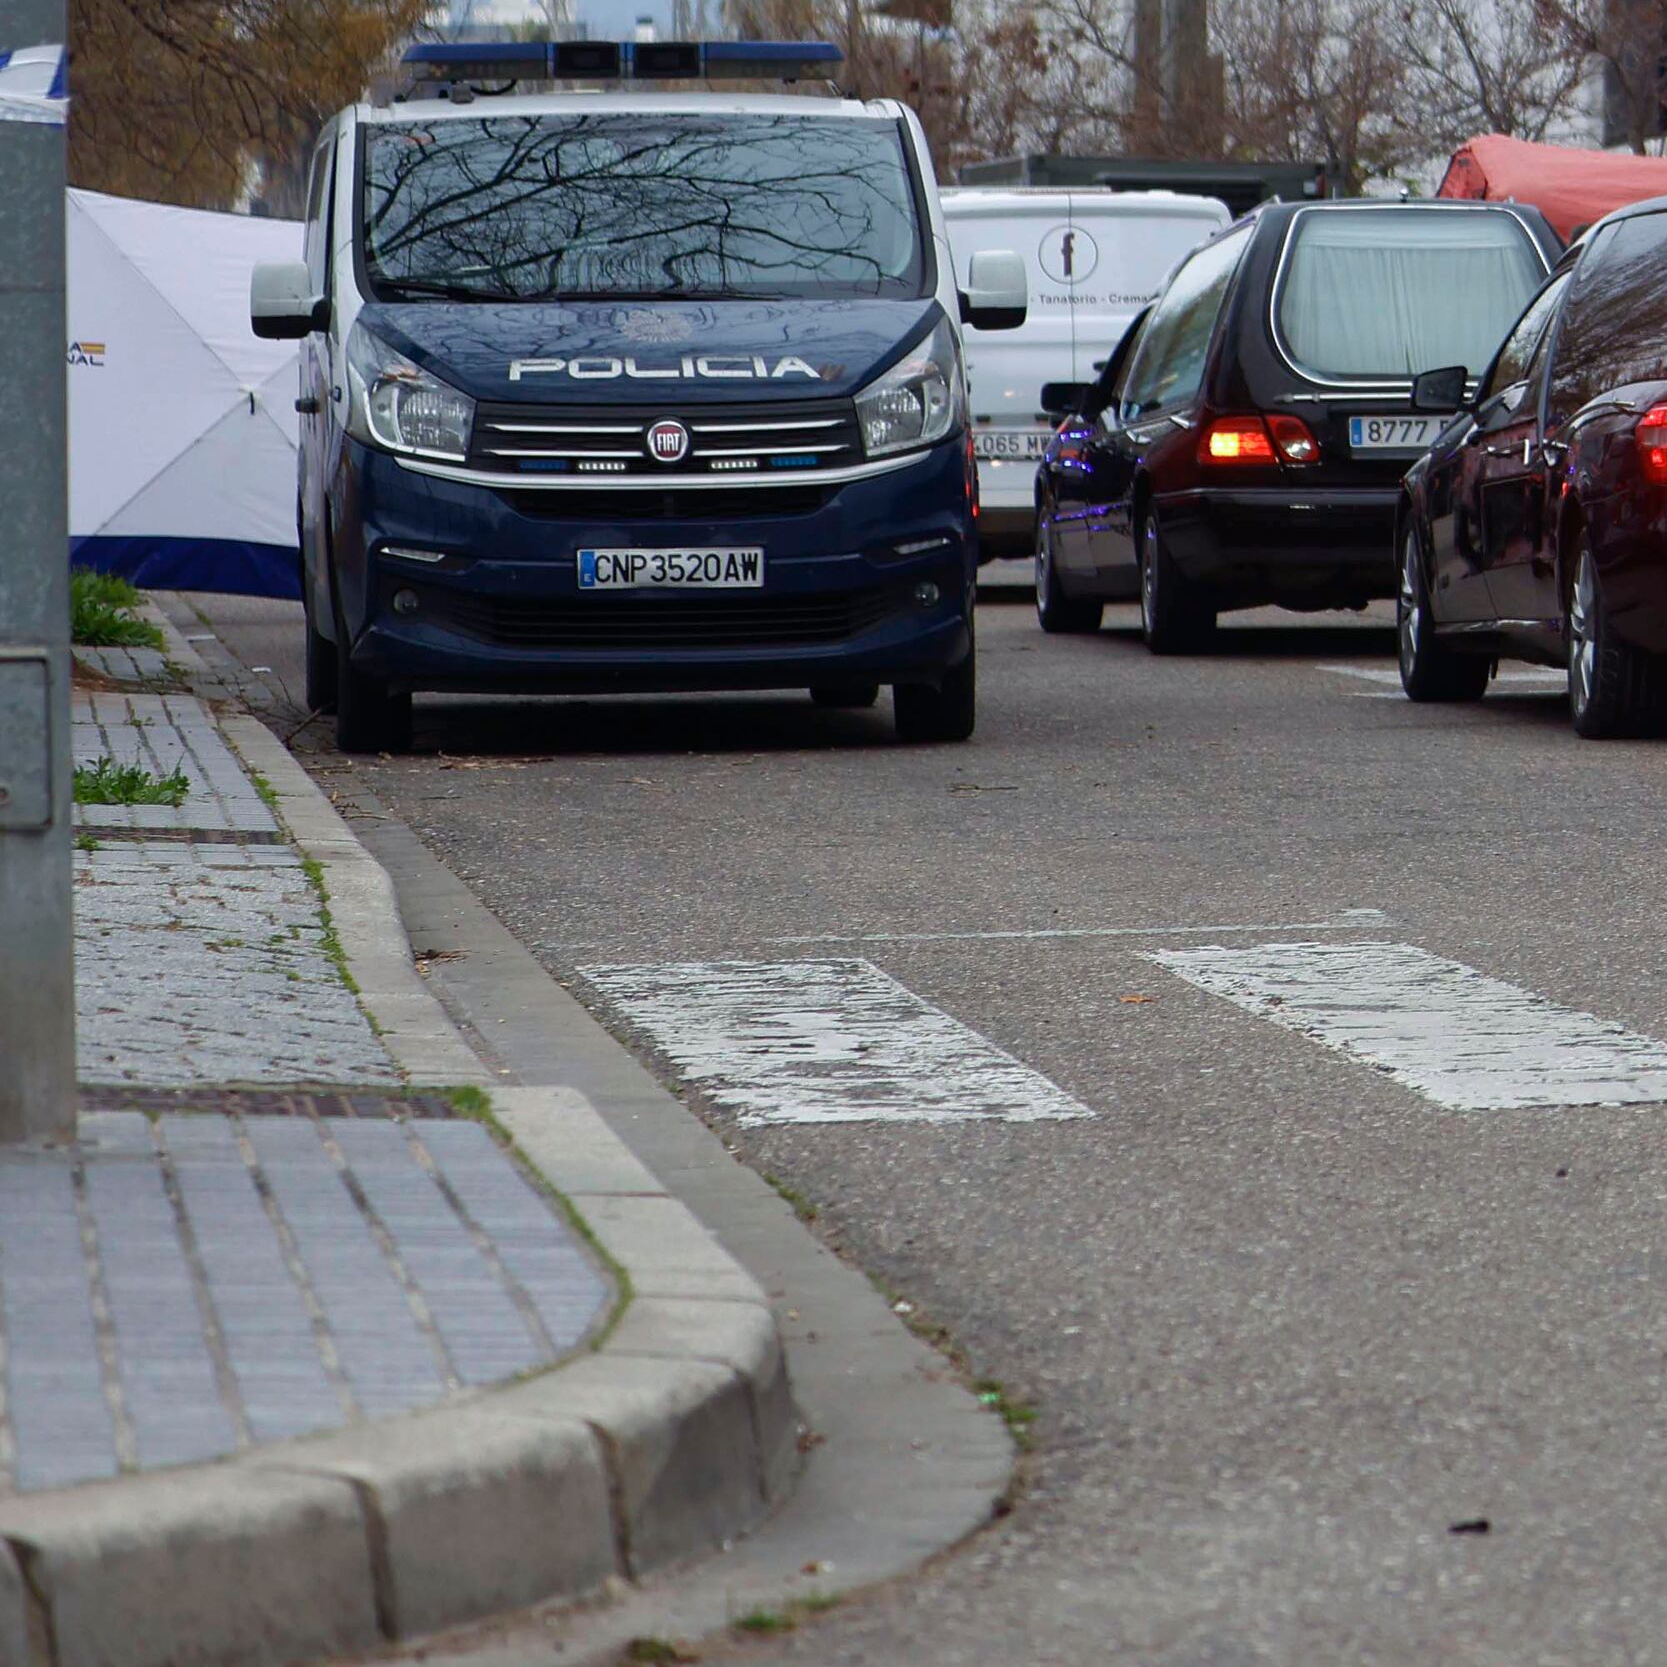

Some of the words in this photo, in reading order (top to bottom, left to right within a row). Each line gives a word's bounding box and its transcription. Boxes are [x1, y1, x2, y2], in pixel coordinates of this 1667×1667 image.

[1039, 294, 1097, 304] Tanatorio
[1109, 294, 1148, 304] Crema
[509, 355, 820, 381] POLICIA
[1368, 421, 1427, 443] 8777
[656, 433, 680, 452] FIAT
